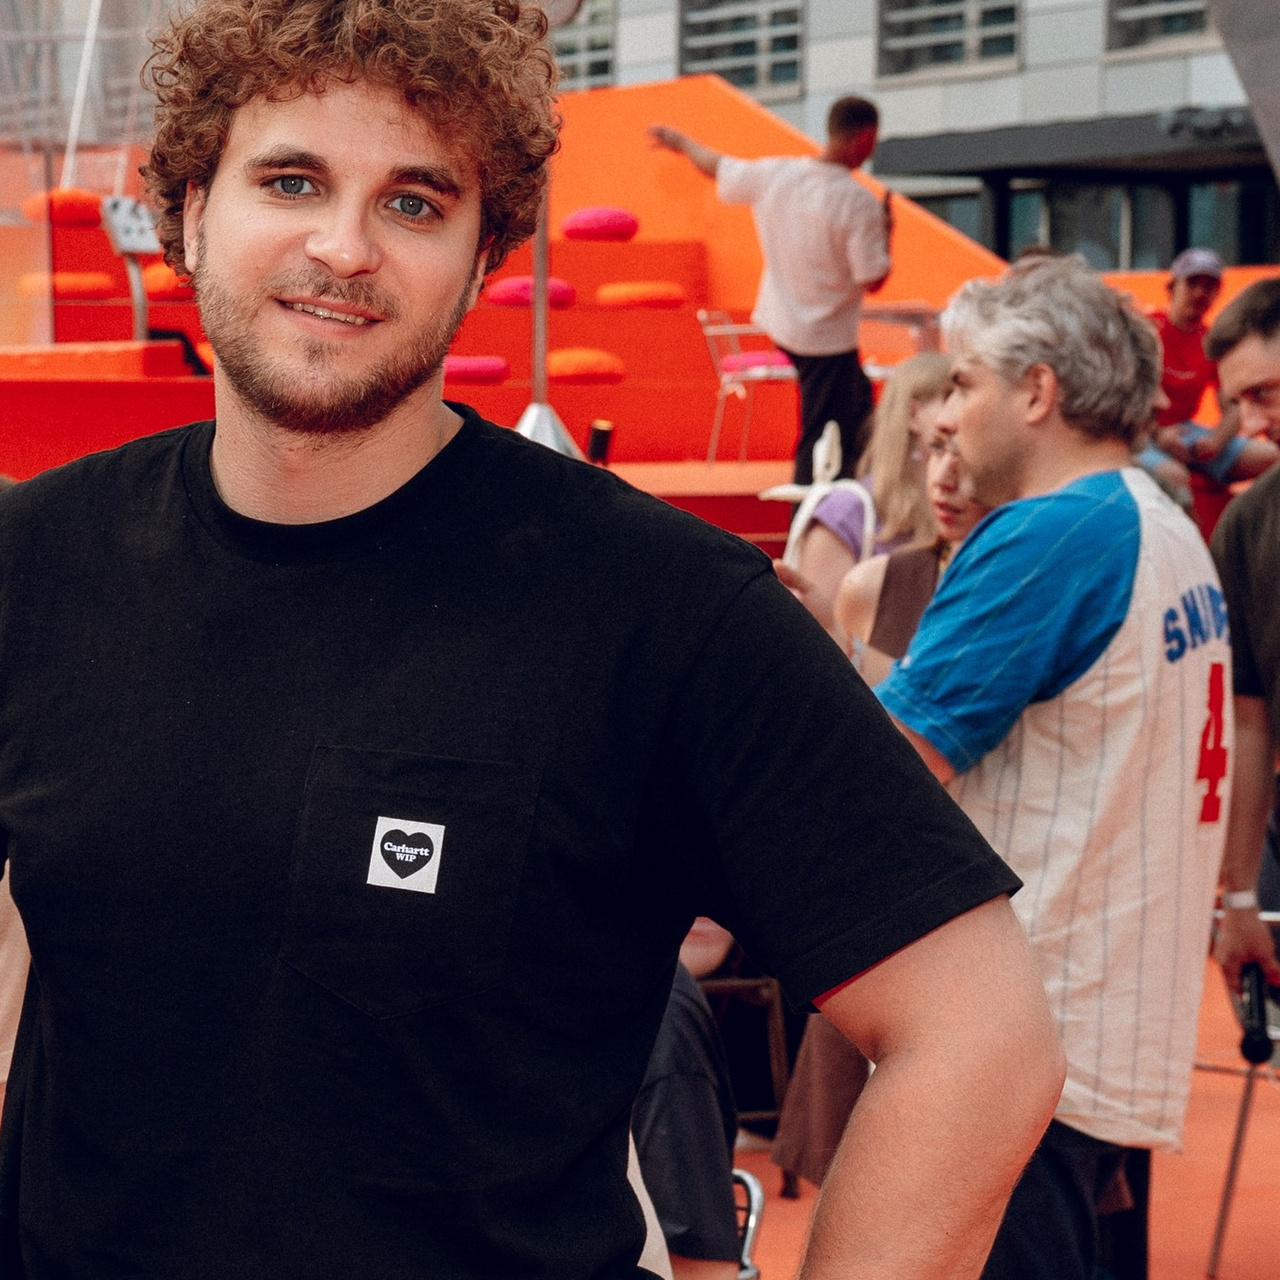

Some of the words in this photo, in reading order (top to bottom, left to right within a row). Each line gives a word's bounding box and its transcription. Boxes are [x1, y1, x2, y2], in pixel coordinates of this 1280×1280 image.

[1196, 662, 1227, 824] 4
[383, 841, 430, 857] Carhartt
[395, 852, 417, 862] WIP
